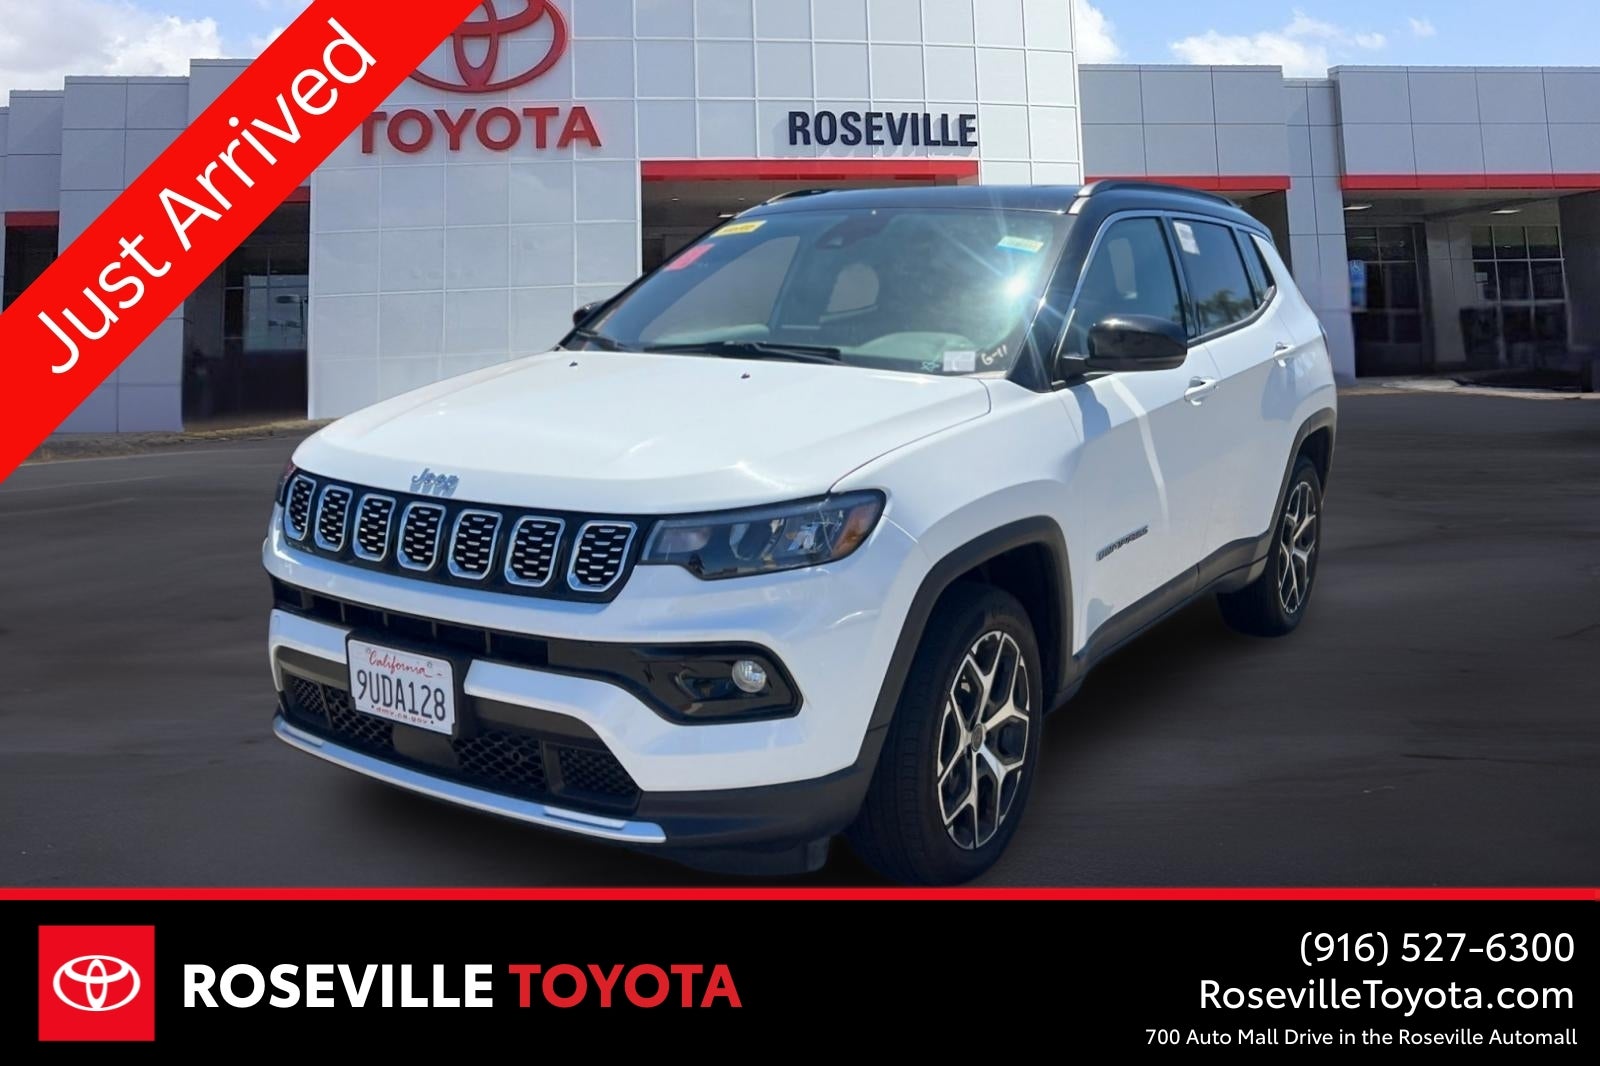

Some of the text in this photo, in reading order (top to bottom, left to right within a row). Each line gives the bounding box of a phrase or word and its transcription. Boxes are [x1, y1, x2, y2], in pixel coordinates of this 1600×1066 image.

[361, 106, 602, 154] TOYOTA
[788, 111, 978, 147] ROSEVILLE
[368, 650, 433, 678] California
[357, 669, 446, 721] 9UDA128
